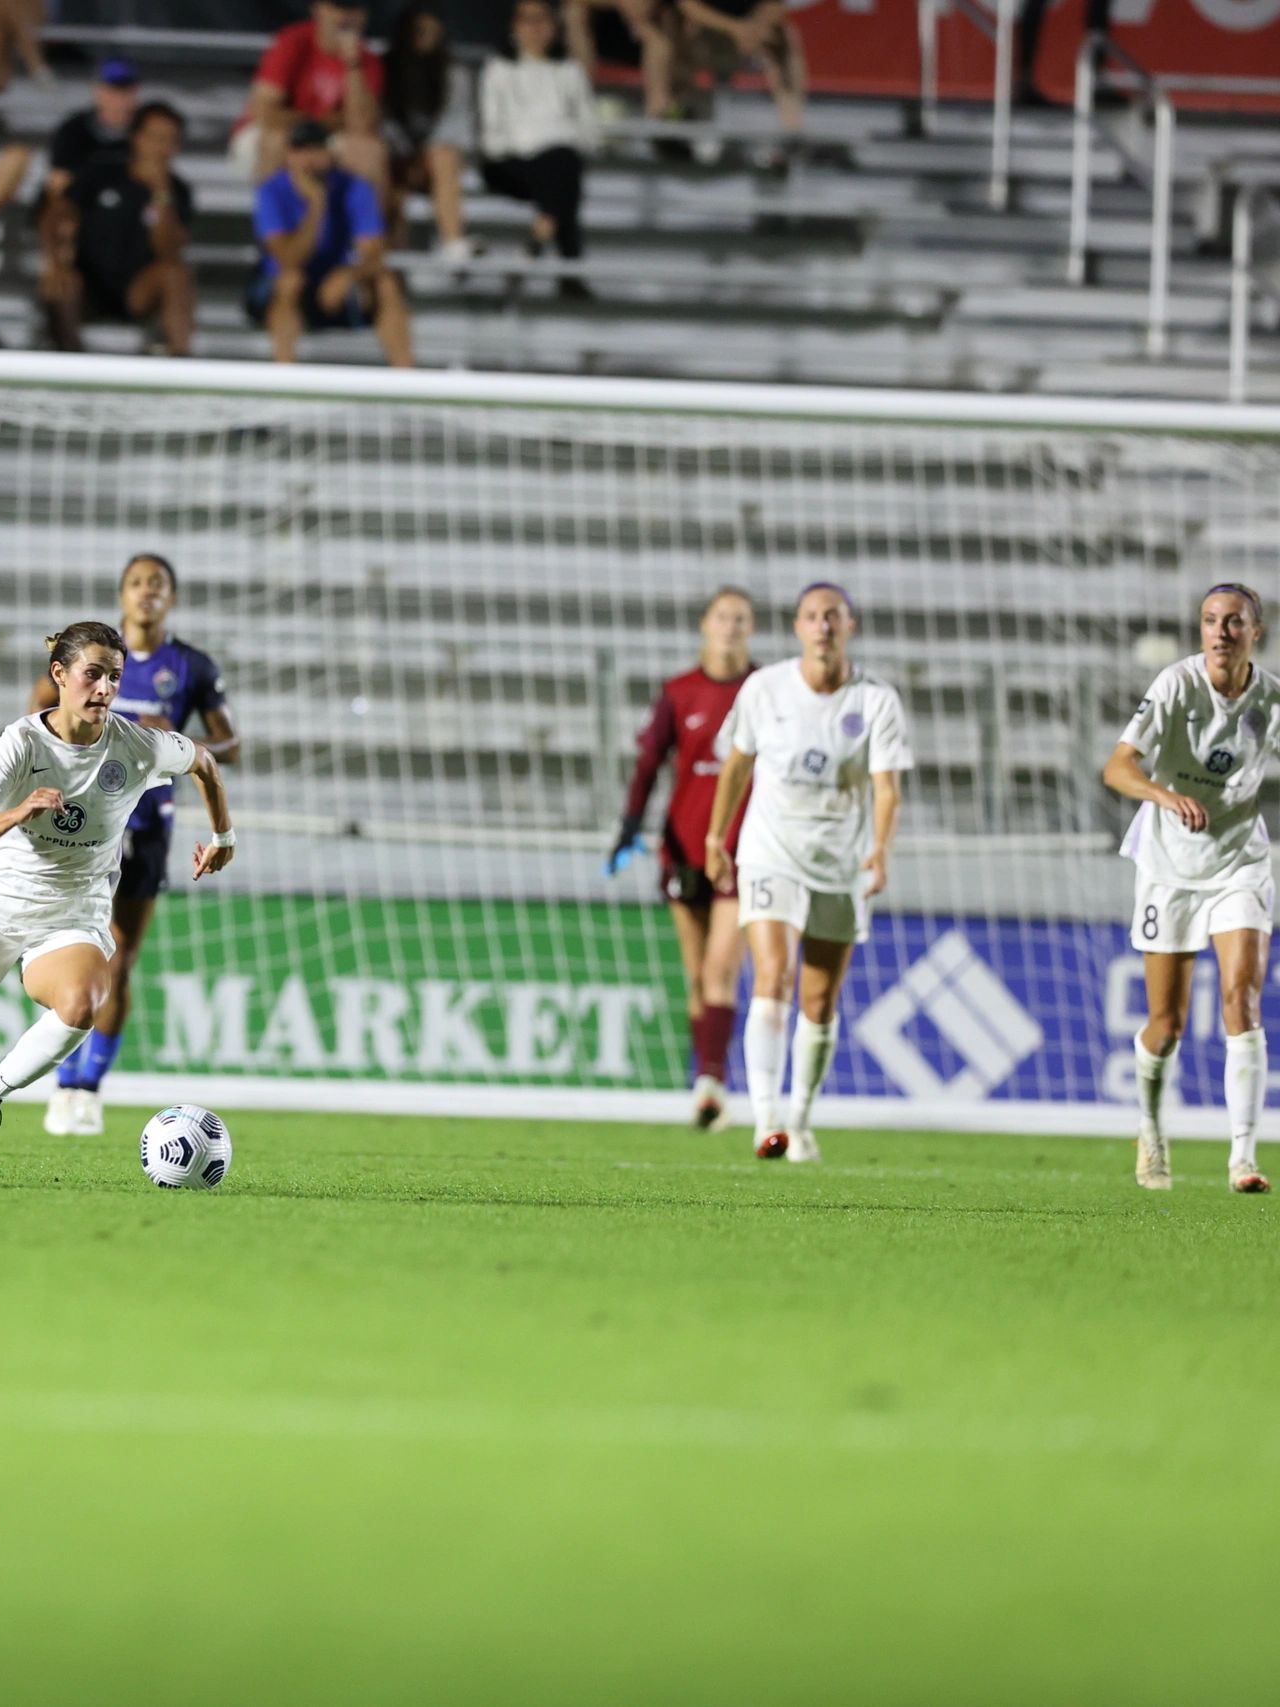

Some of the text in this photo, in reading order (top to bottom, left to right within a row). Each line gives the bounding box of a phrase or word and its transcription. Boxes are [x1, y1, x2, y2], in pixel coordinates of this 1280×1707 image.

[749, 877, 774, 910] 15
[1142, 904, 1159, 941] 8
[158, 972, 656, 1078] MARKET
